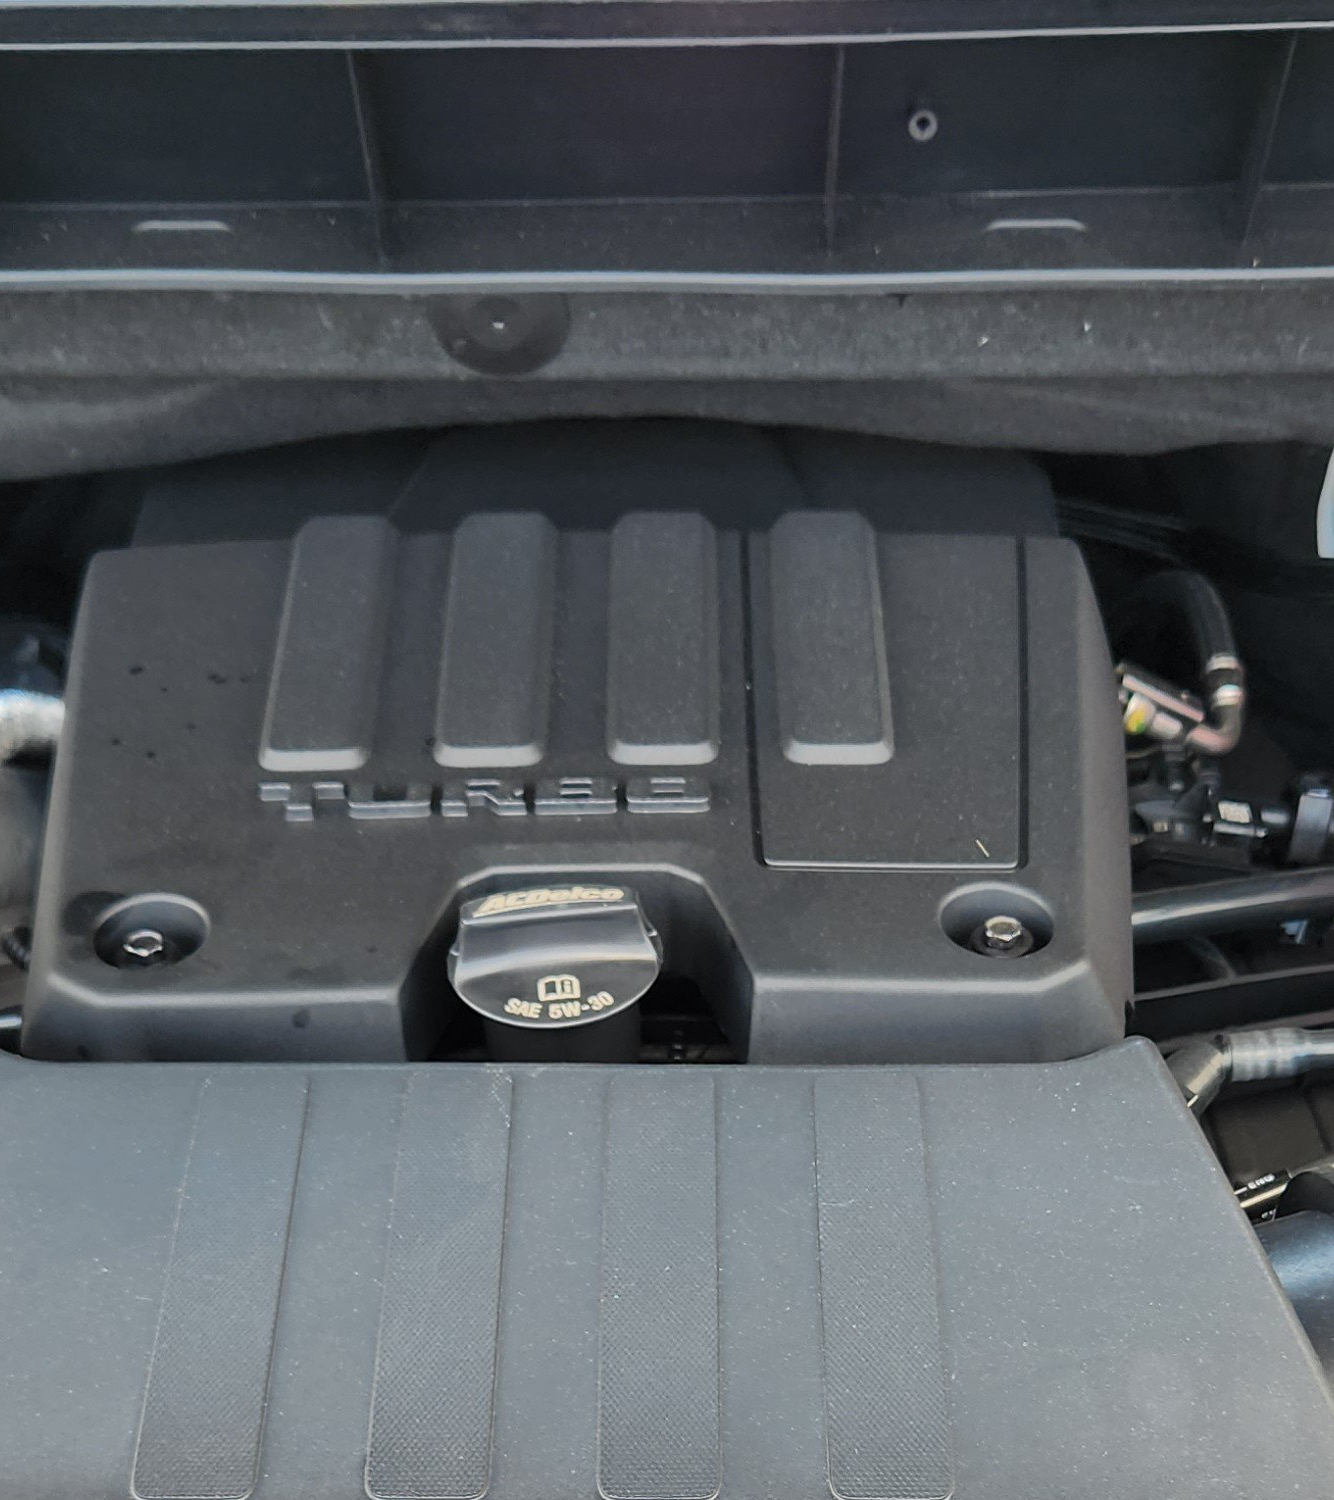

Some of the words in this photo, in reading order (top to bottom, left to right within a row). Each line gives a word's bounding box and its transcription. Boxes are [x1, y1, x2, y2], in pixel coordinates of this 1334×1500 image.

[258, 775, 712, 822] TURBO
[473, 886, 625, 918] ACDelco
[504, 997, 543, 1019] SAE
[548, 990, 615, 1019] 5W-30
